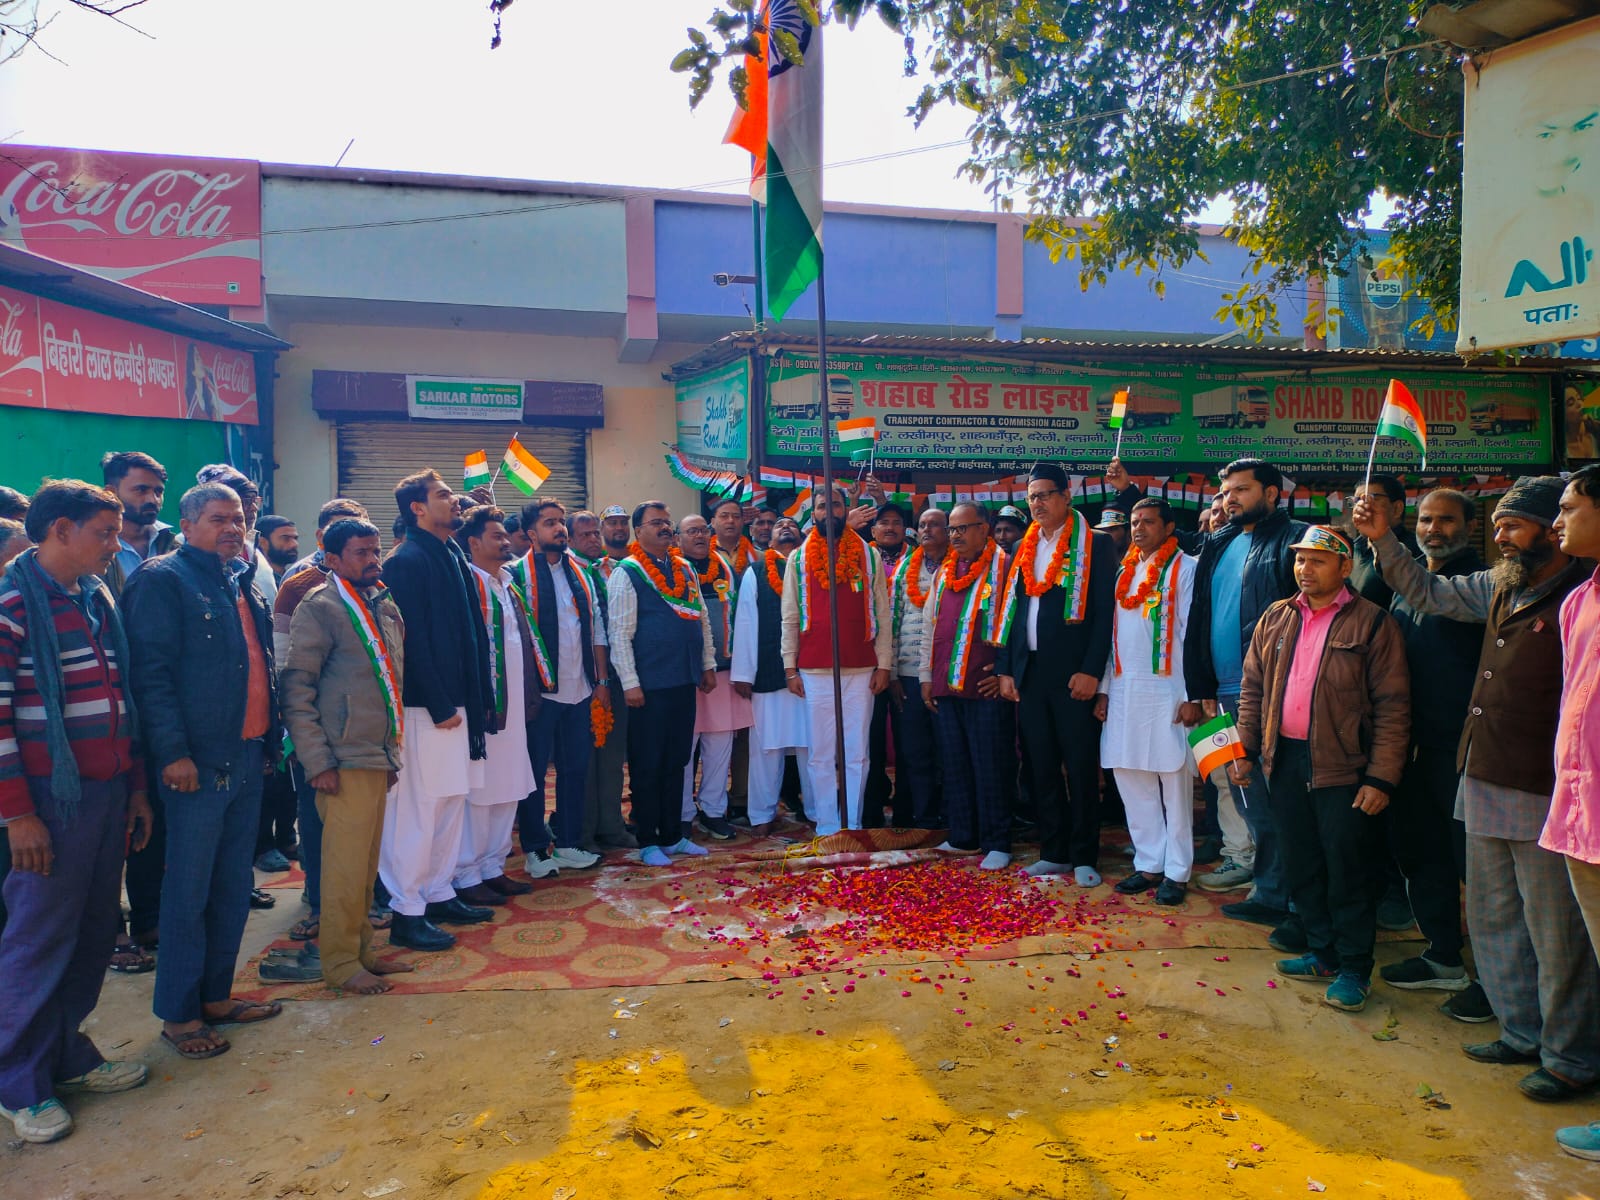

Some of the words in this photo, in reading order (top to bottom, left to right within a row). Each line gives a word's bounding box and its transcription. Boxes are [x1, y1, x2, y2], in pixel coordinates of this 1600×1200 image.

[0, 160, 245, 239] Coca-Cola
[1367, 282, 1401, 293] PEPSI
[44, 322, 84, 376] बिहारी
[85, 345, 112, 381] लाल
[147, 357, 176, 389] भण्डार
[419, 390, 467, 403] SARKAR
[470, 392, 519, 405] MOTORS
[859, 379, 939, 409] शहाब
[946, 373, 993, 409] रोड
[1000, 383, 1092, 415] लाइन्स
[1274, 384, 1344, 420] SHAHB
[887, 416, 934, 424] TRANSPORT
[936, 417, 988, 425] CONTRACTOR
[990, 417, 996, 425] &
[998, 418, 1049, 427] COMMISSION
[1051, 419, 1076, 428] AGENT
[1296, 424, 1336, 432] TRANSPORT
[1338, 425, 1377, 433] CONTRACTO
[1433, 426, 1454, 434] AGENT
[883, 444, 913, 454] भारत
[874, 458, 893, 469] सिंह
[1302, 464, 1339, 473] Market,
[1463, 464, 1504, 473] Lucknow
